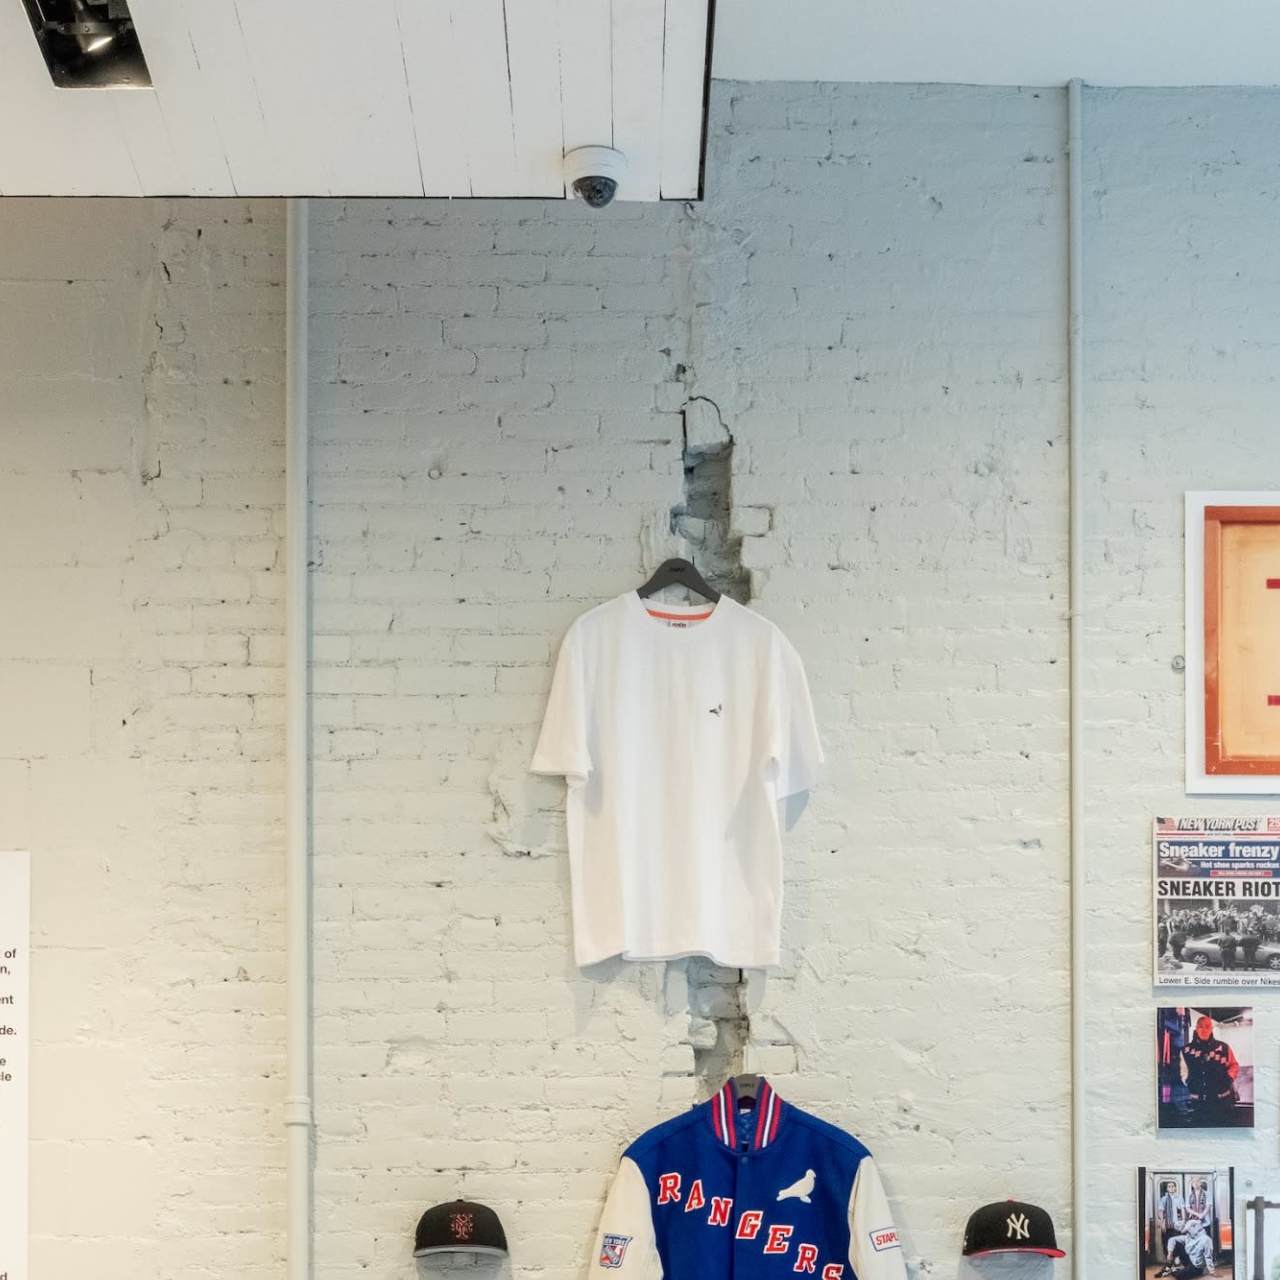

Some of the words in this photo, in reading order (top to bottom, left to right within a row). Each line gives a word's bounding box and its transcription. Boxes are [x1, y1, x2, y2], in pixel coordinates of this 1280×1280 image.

[1177, 818, 1202, 831] NEW
[1234, 818, 1261, 831] POST
[1159, 842, 1225, 858] Sneaker
[1229, 842, 1280, 860] frenzy
[1158, 880, 1236, 897] SNEAKER
[4, 948, 16, 959] of
[1158, 976, 1182, 985] Lower
[1184, 977, 1192, 985] E.
[1194, 976, 1211, 985] Side
[1212, 977, 1239, 985] rumble
[1260, 977, 1280, 985] Nikes
[1006, 1213, 1031, 1240] NY
[875, 1231, 899, 1246] STAPL
